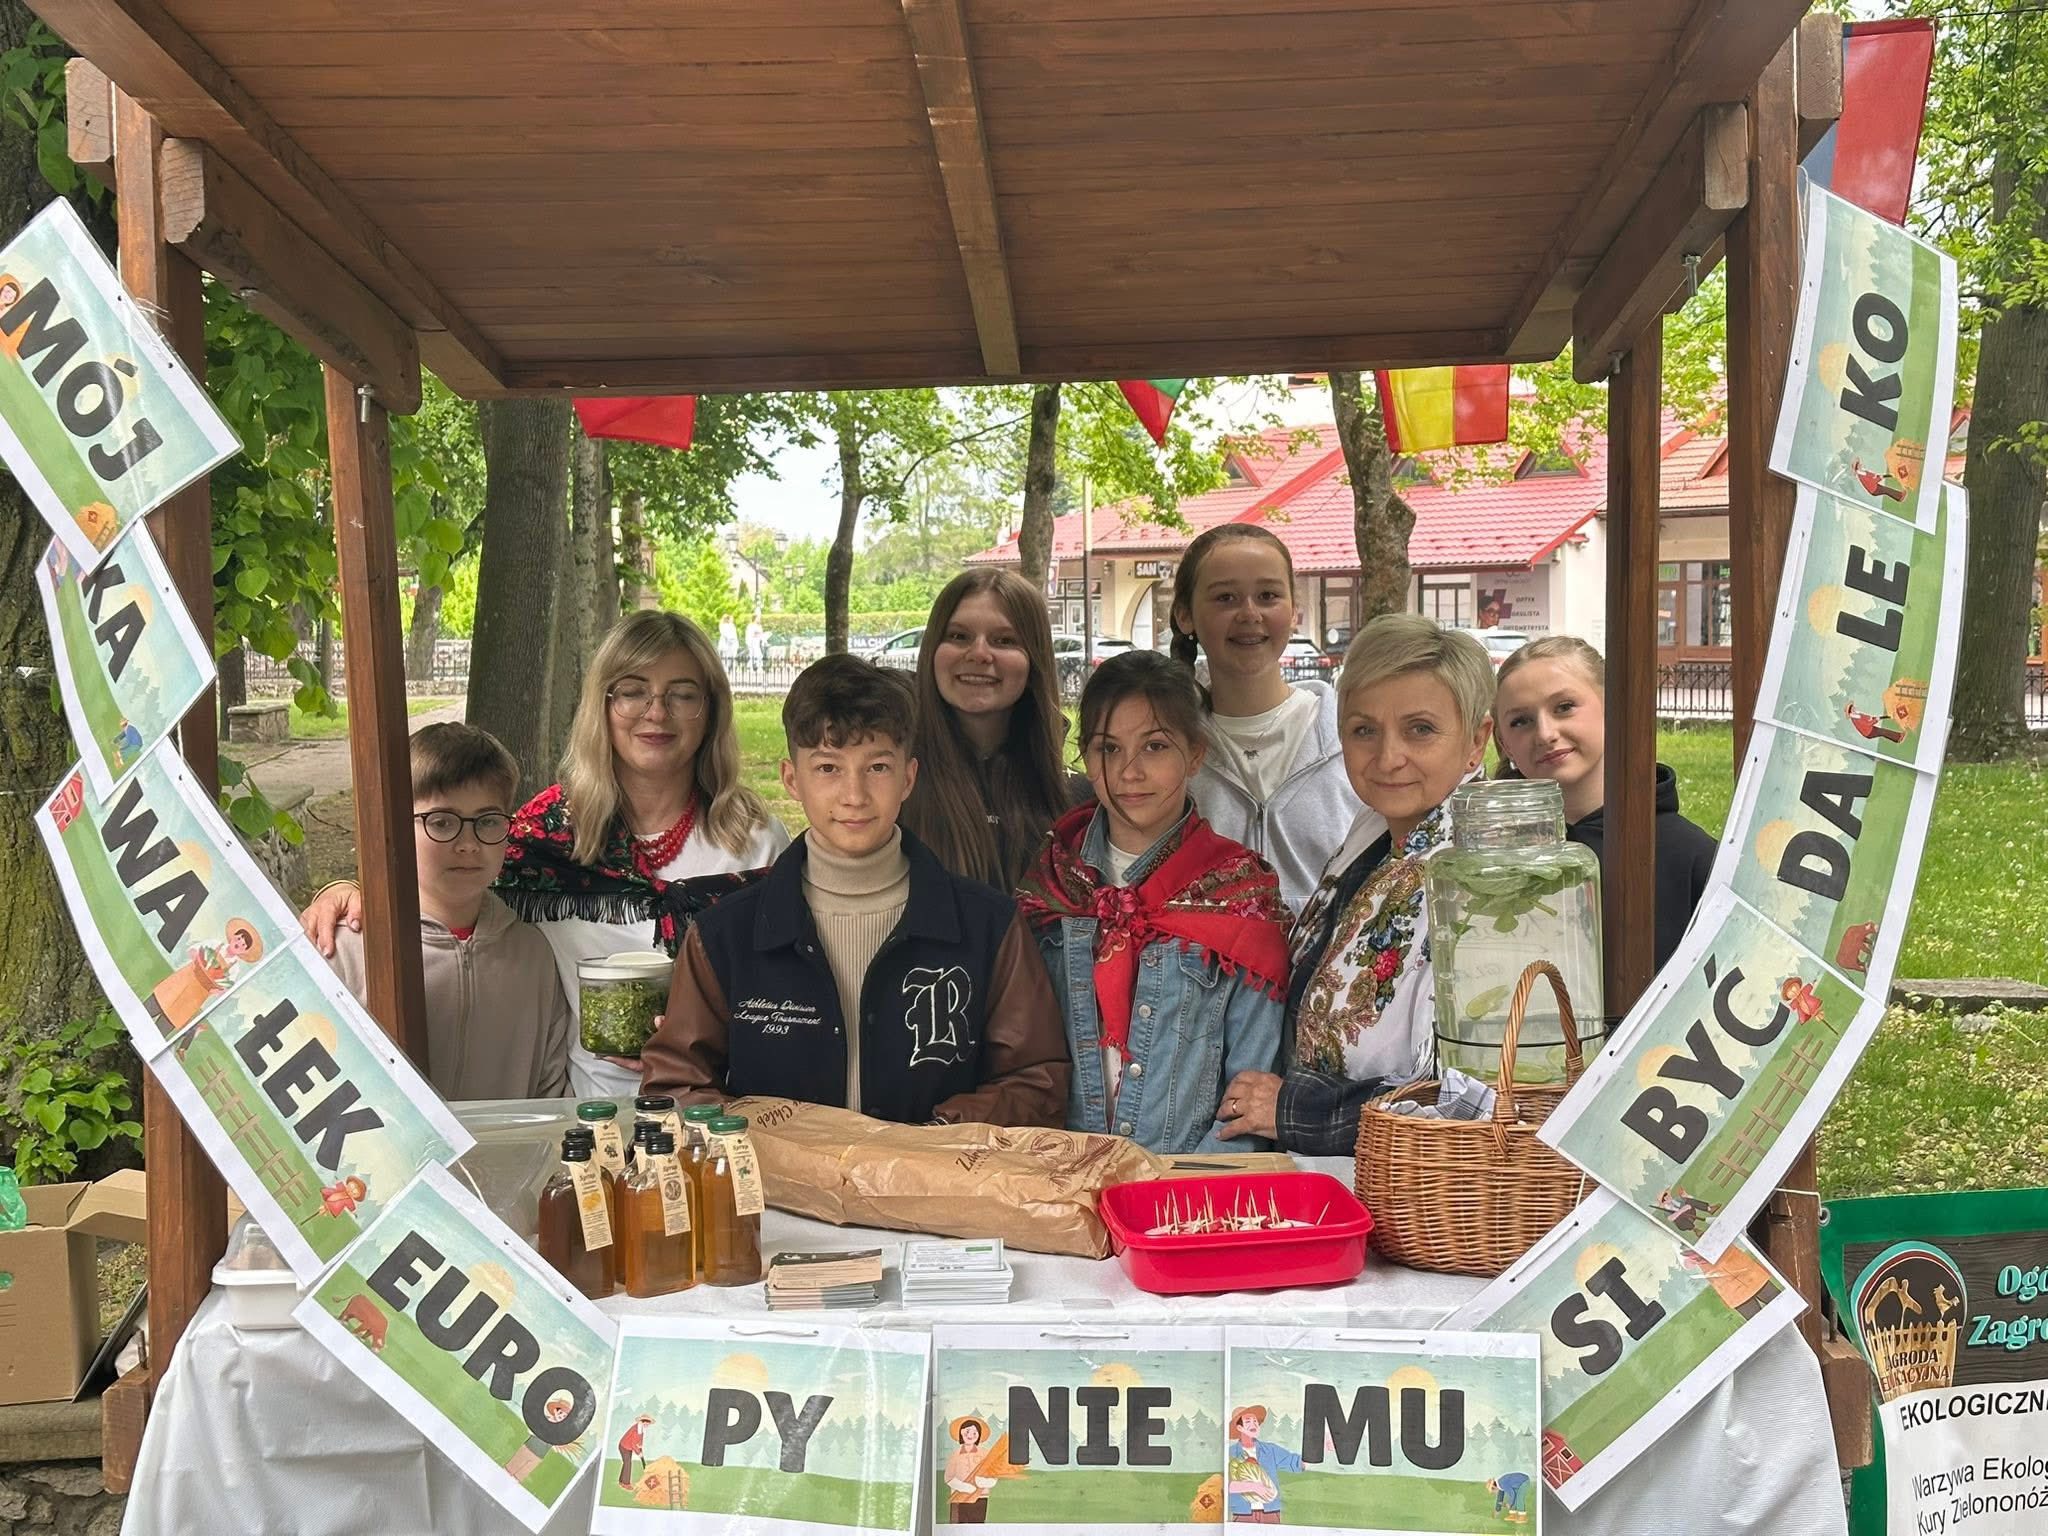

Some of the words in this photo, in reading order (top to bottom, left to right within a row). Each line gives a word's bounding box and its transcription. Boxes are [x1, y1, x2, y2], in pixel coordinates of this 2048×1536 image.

[1, 277, 164, 482] MÓJ
[1840, 292, 1909, 432] KO
[79, 563, 147, 684] KA
[1836, 544, 1910, 652] LE
[101, 776, 210, 954] WA
[1776, 770, 1874, 902] DA
[734, 1010, 769, 1024] League
[771, 1011, 822, 1025] Tournament
[738, 997, 778, 1010] Athletics
[780, 1000, 816, 1013] Division
[762, 1023, 790, 1035] 1993
[234, 997, 384, 1171] ŁEK
[1620, 953, 1790, 1165] BYĆ
[757, 1105, 793, 1128] Chleb
[366, 1229, 596, 1446] EURO
[1551, 1255, 1667, 1376] SI
[700, 1387, 834, 1474] PY
[1007, 1385, 1174, 1466] NIE
[1300, 1382, 1465, 1470] MU
[1900, 1389, 2048, 1431] EKOLOGICZN
[1912, 1464, 1974, 1501] Warzywa
[1916, 1508, 1946, 1536] Kury
